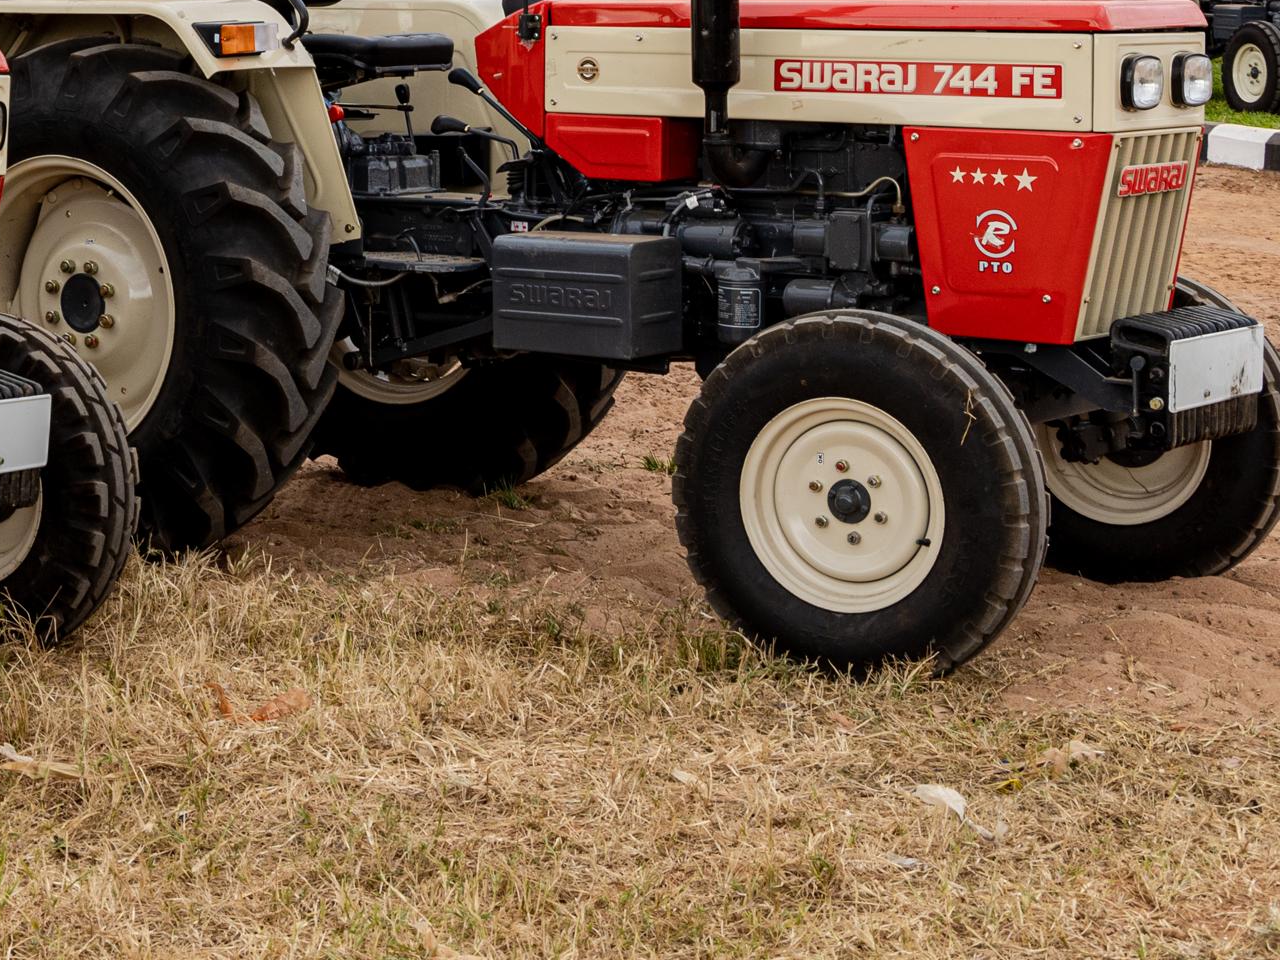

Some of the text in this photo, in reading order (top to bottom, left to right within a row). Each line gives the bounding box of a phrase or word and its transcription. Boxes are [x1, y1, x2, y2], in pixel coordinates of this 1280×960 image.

[932, 65, 998, 96] 744
[1011, 66, 1057, 98] FE
[978, 260, 1013, 274] PTO
